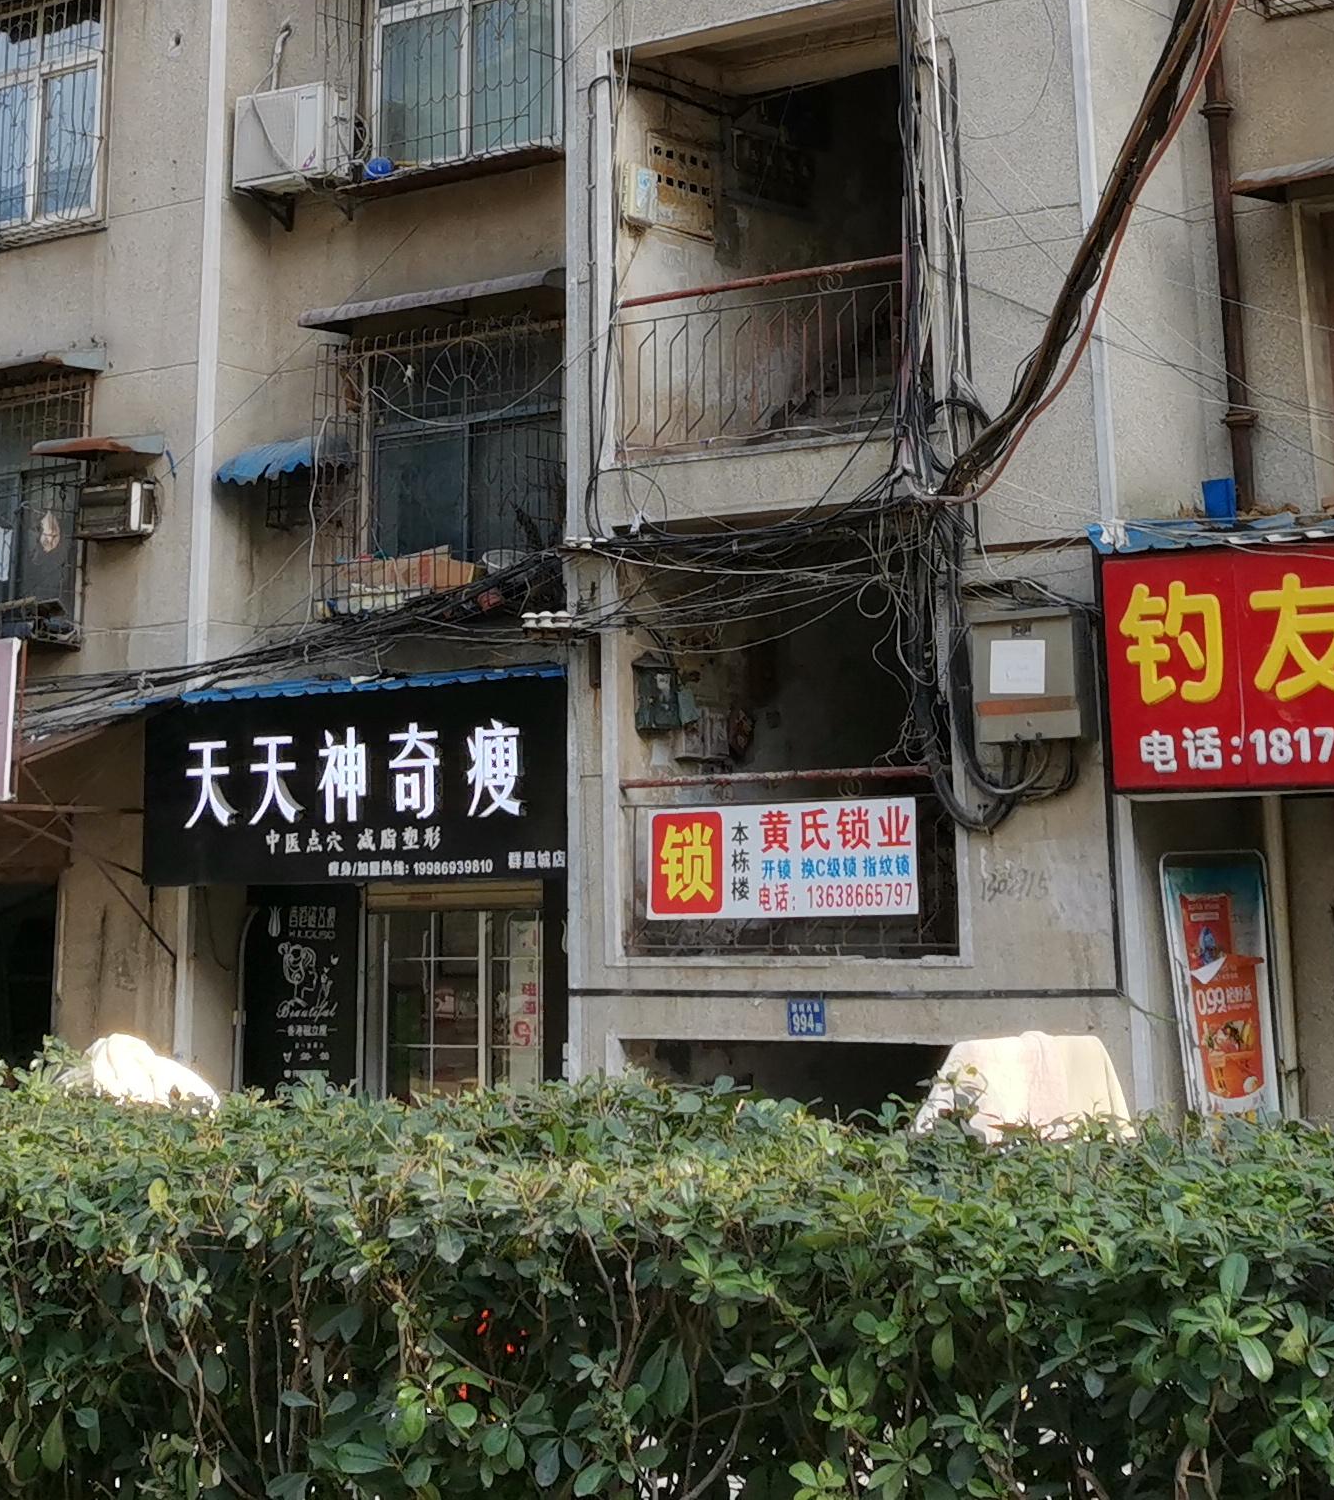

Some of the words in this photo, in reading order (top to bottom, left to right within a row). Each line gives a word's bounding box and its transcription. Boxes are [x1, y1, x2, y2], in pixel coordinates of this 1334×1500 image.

[184, 718, 526, 829] 天天神奇瘦
[265, 828, 344, 854] 中医点穴
[357, 826, 442, 853] 减脂塑形
[730, 820, 752, 903] 本栋楼
[759, 806, 912, 854] 黄氏锁业
[660, 822, 716, 905] 锁
[761, 858, 792, 881] 开锁
[801, 855, 857, 879] 换C级锁
[862, 853, 910, 878] 指纹锁
